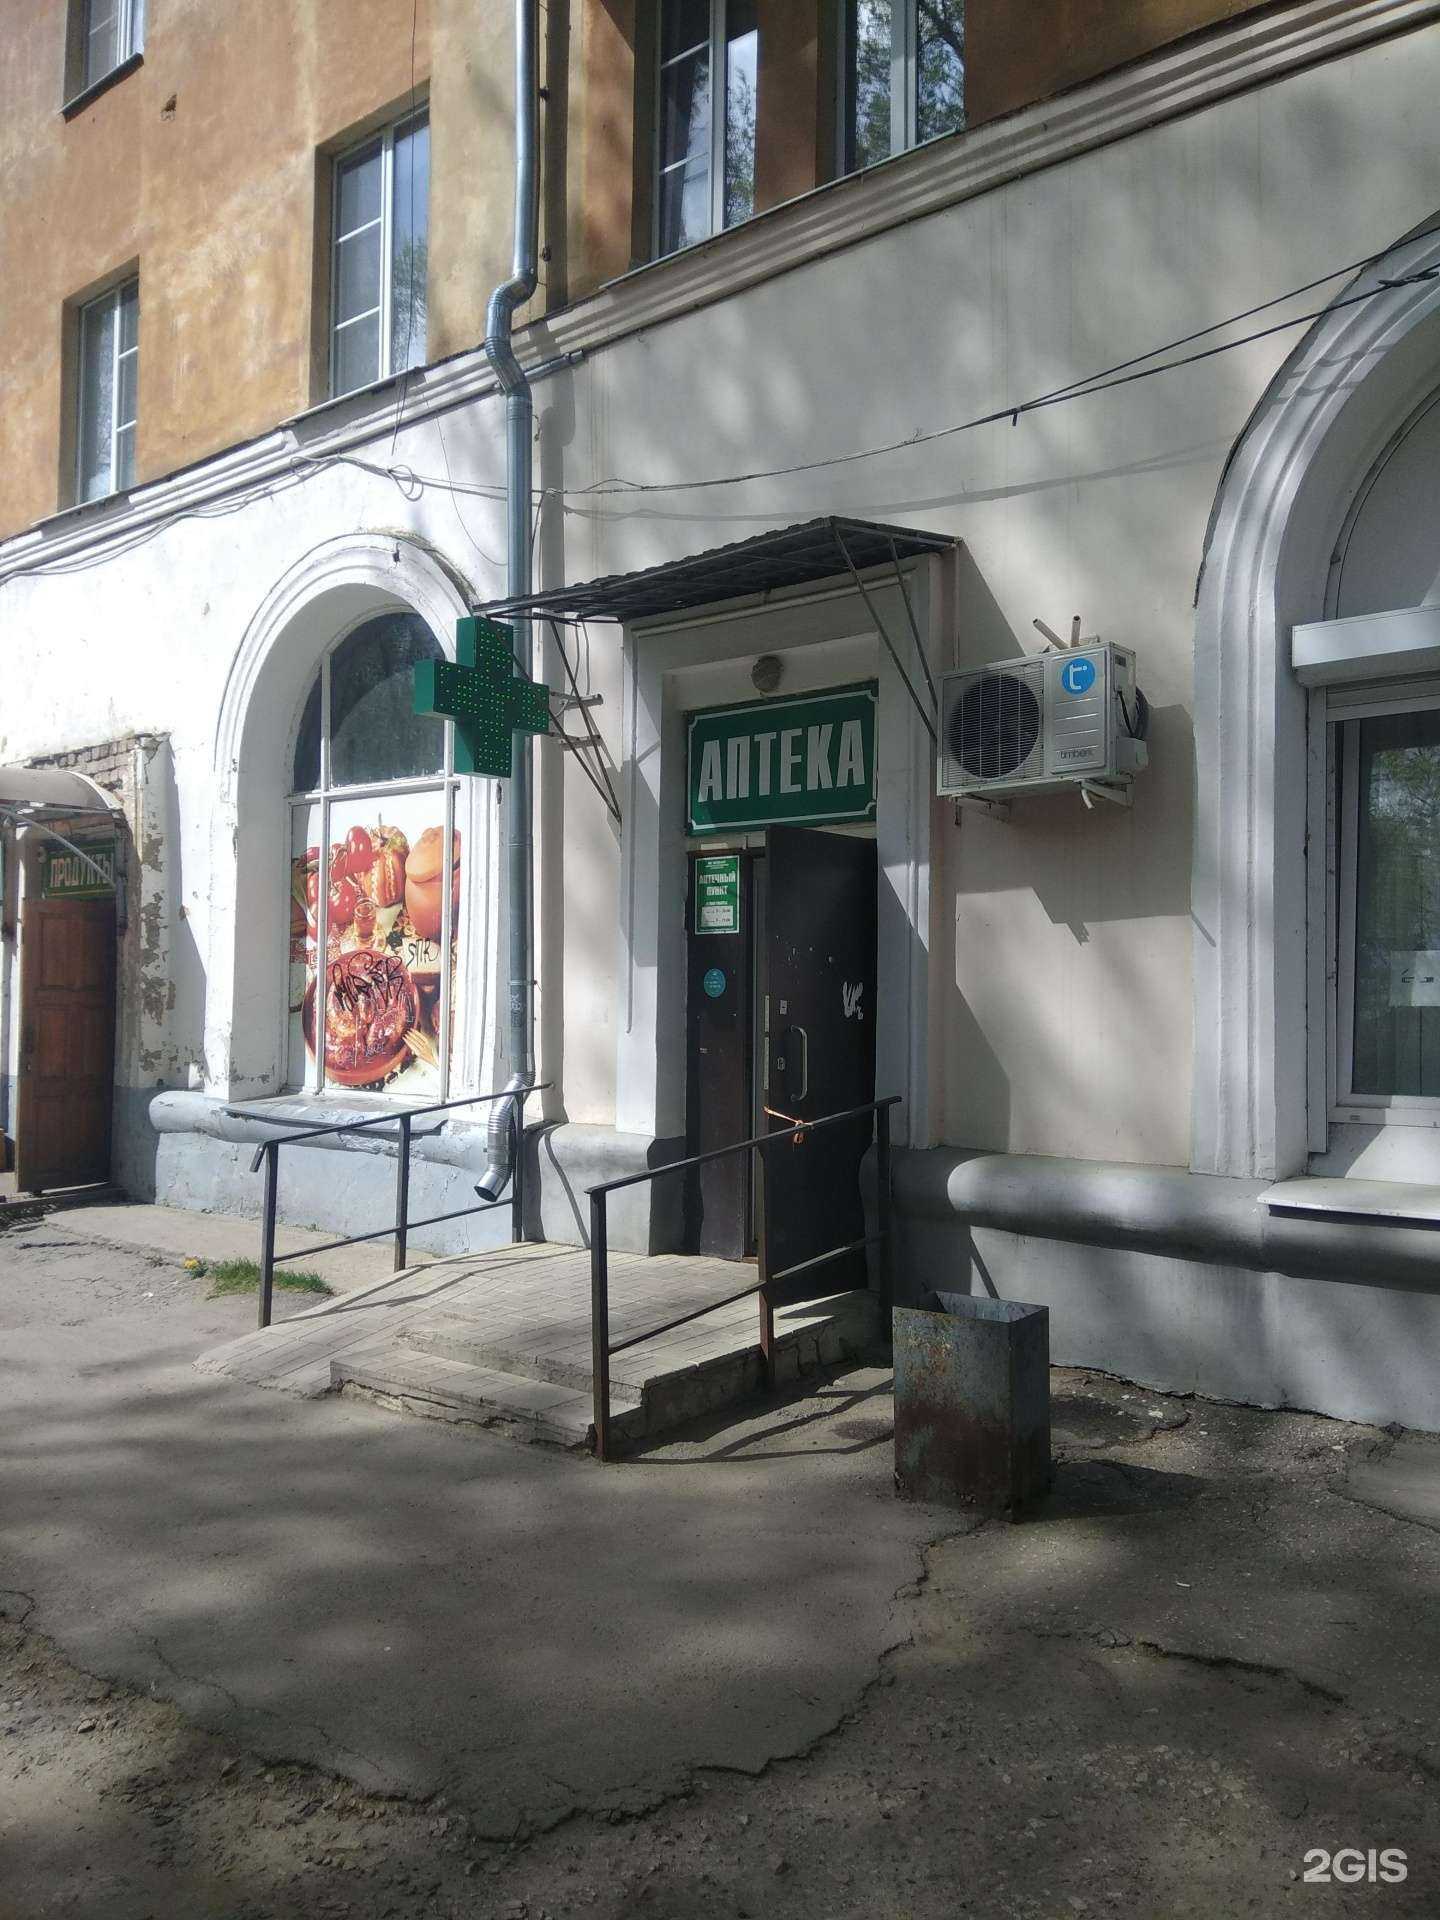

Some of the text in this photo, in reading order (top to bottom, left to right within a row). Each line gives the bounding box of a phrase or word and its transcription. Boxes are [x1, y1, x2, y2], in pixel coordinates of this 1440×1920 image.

[697, 719, 866, 803] АПТЕКА
[50, 852, 115, 888] ПРОДУКТЫ
[698, 871, 736, 885] АПТЕЧНЫЙ
[706, 885, 729, 897] ПУНКТ
